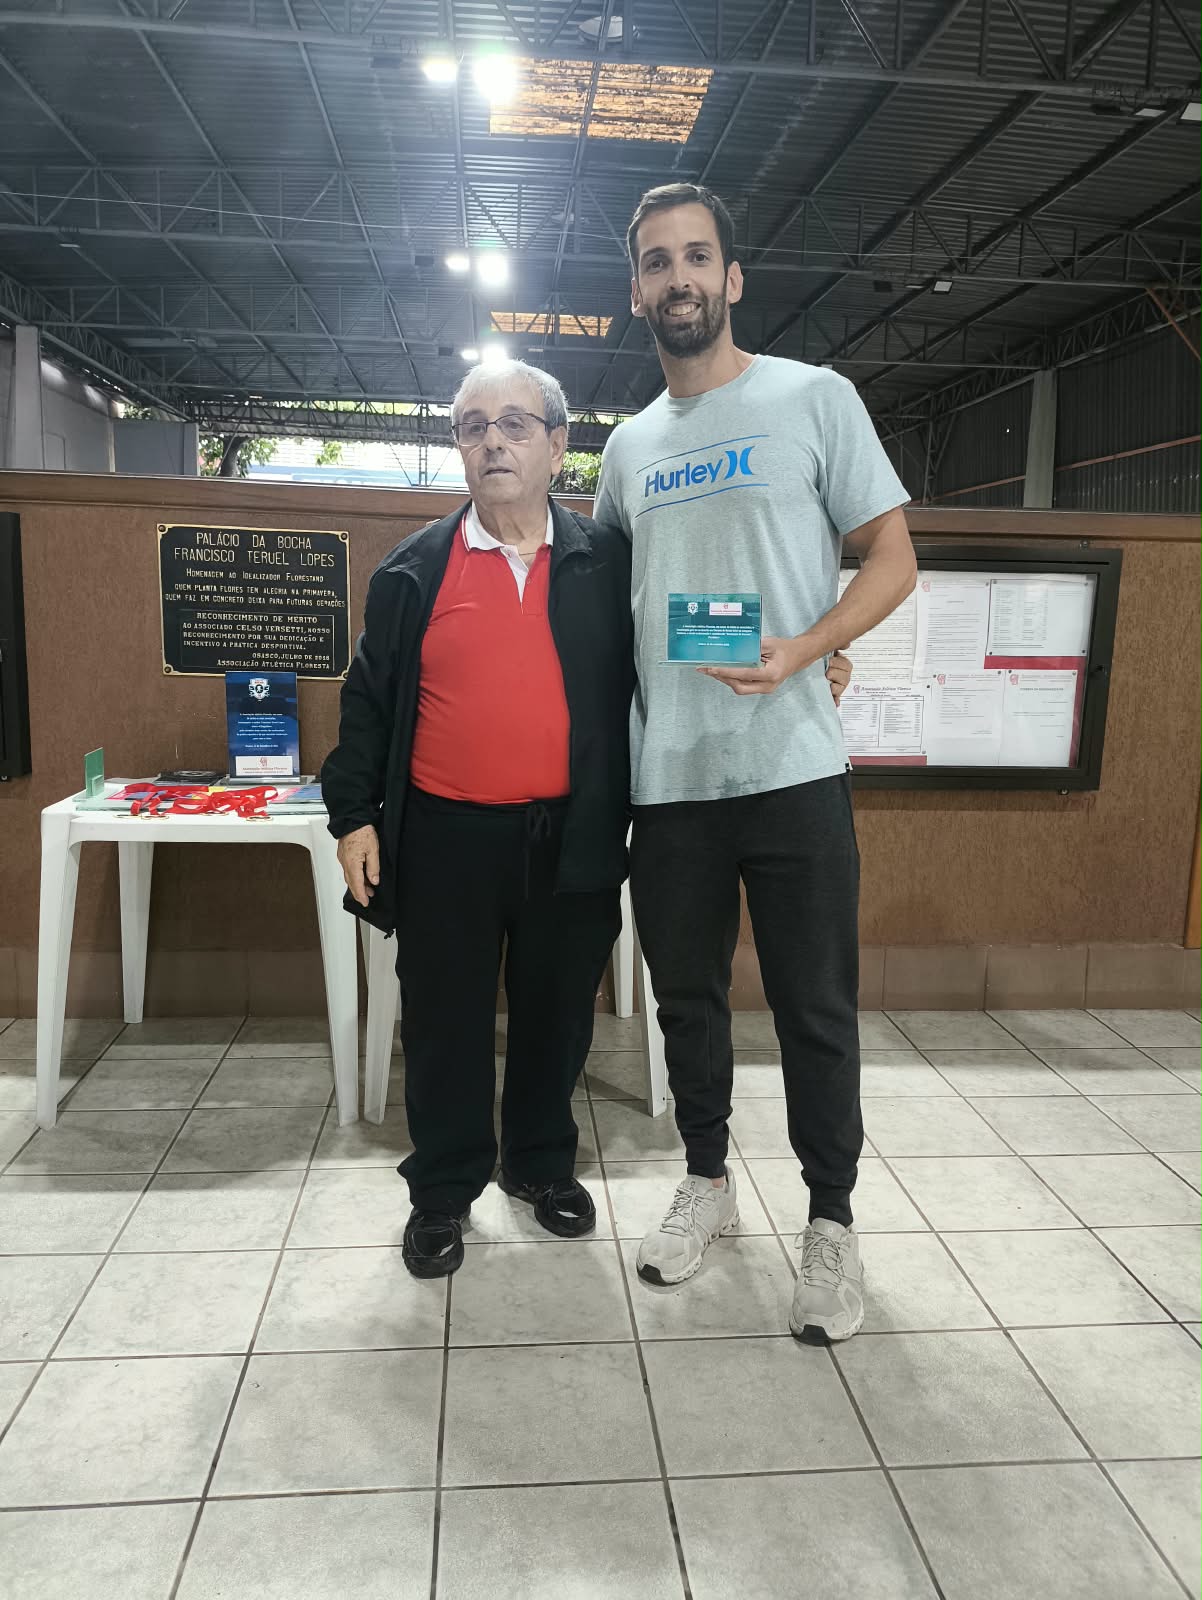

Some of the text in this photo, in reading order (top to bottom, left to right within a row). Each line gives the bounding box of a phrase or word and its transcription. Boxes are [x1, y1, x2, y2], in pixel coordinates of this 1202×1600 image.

[644, 458, 723, 498] Hurley
[196, 531, 312, 550] PALÁCIO DA BOCHA
[174, 547, 335, 567] FRANCISCO TERUEL LOPES
[174, 583, 192, 591] QUEM
[194, 584, 217, 592] PLANTA
[220, 585, 244, 594] FLORES
[246, 586, 259, 594] TEM
[263, 587, 287, 595] ALEGRIA
[165, 593, 181, 601] QUEM
[185, 594, 196, 602] FAZ
[212, 595, 244, 604] CONCRETO
[269, 597, 284, 605] PARA
[286, 598, 313, 607] FUTURAS
[196, 612, 318, 624] RECONHECIMENTO DE MERITO
[183, 631, 246, 639] RECONHECIMENTO
[279, 634, 317, 643] DEDICAÇÃO
[261, 643, 306, 651] DESPORTIVA.
[261, 661, 294, 669] ATLÉTICA
[296, 662, 330, 670] FLORESTA
